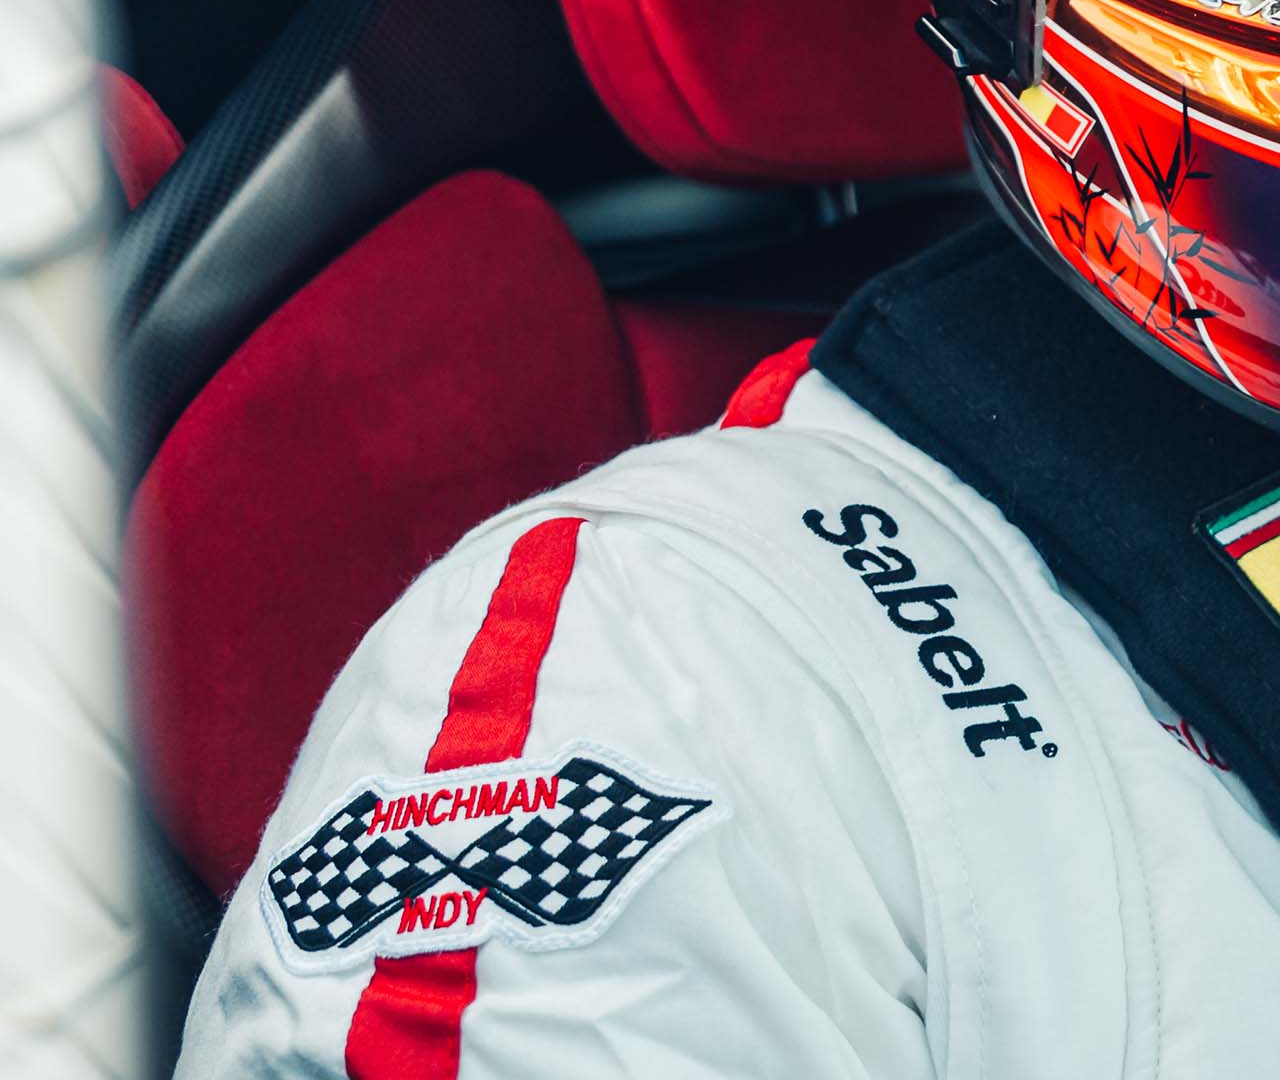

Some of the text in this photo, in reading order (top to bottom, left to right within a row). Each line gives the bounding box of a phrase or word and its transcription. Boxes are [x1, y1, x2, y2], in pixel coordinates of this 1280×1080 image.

[802, 503, 1043, 758] Sabelt
[367, 776, 559, 835] HINCHMAN
[397, 887, 489, 934] INDY
